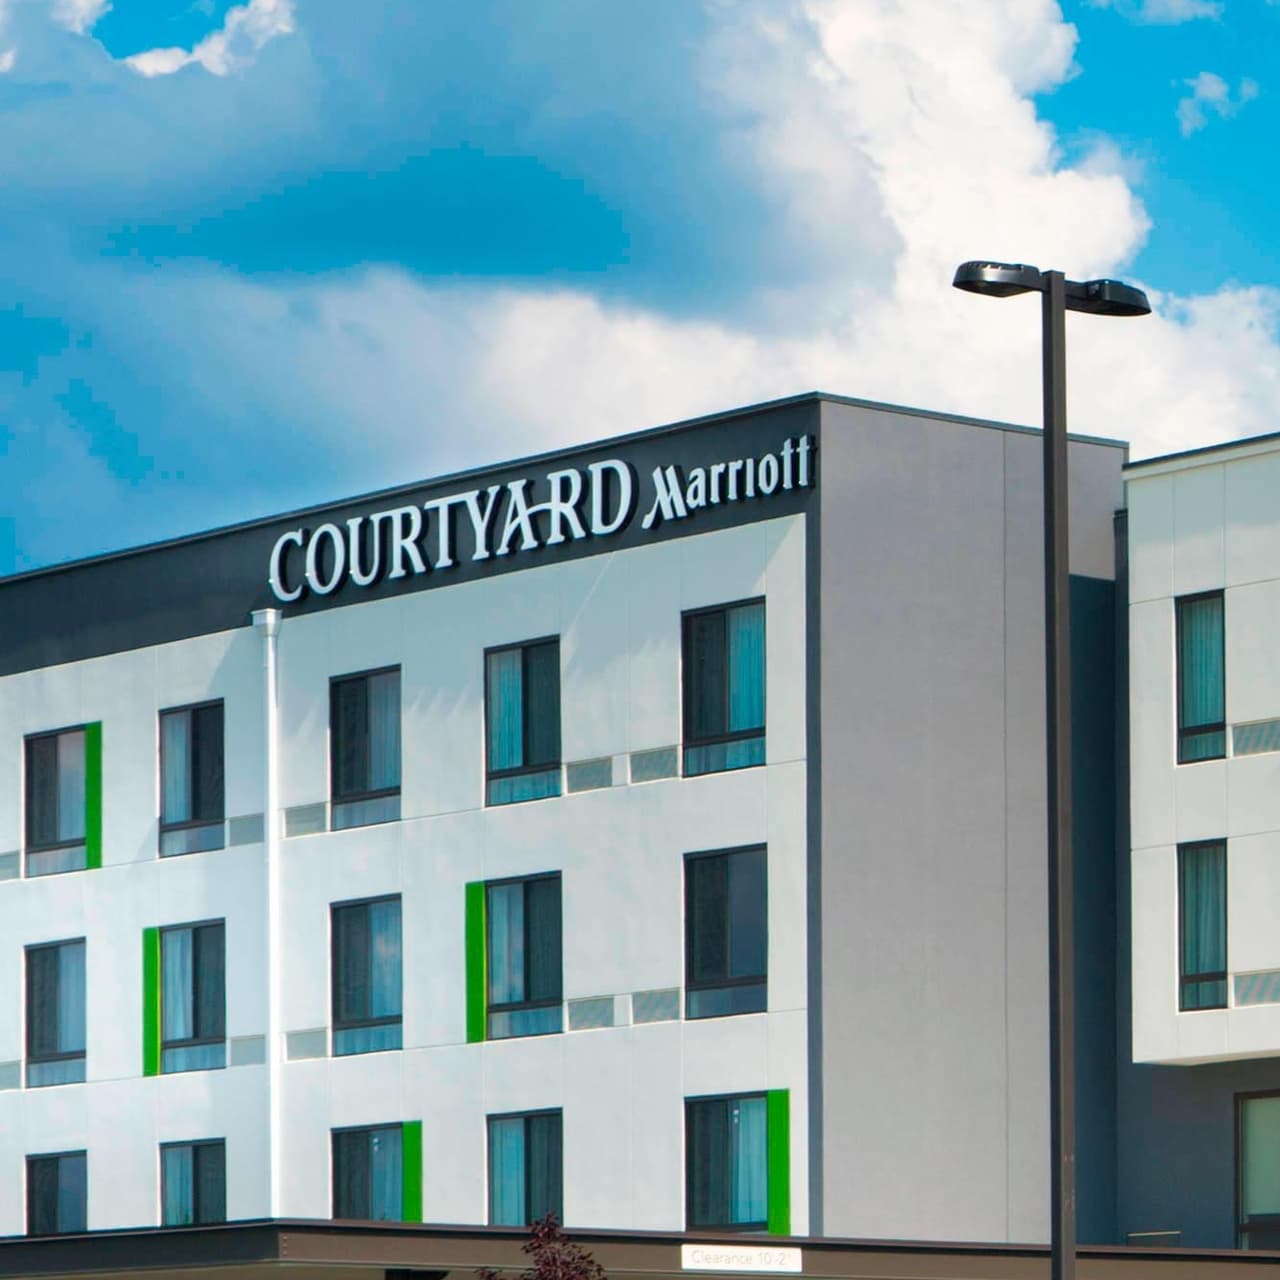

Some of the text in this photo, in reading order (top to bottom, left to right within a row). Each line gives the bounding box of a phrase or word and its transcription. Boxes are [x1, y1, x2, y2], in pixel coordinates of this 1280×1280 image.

[268, 434, 813, 603] COURTYARD Marriott
[691, 1249, 753, 1265] Clearance
